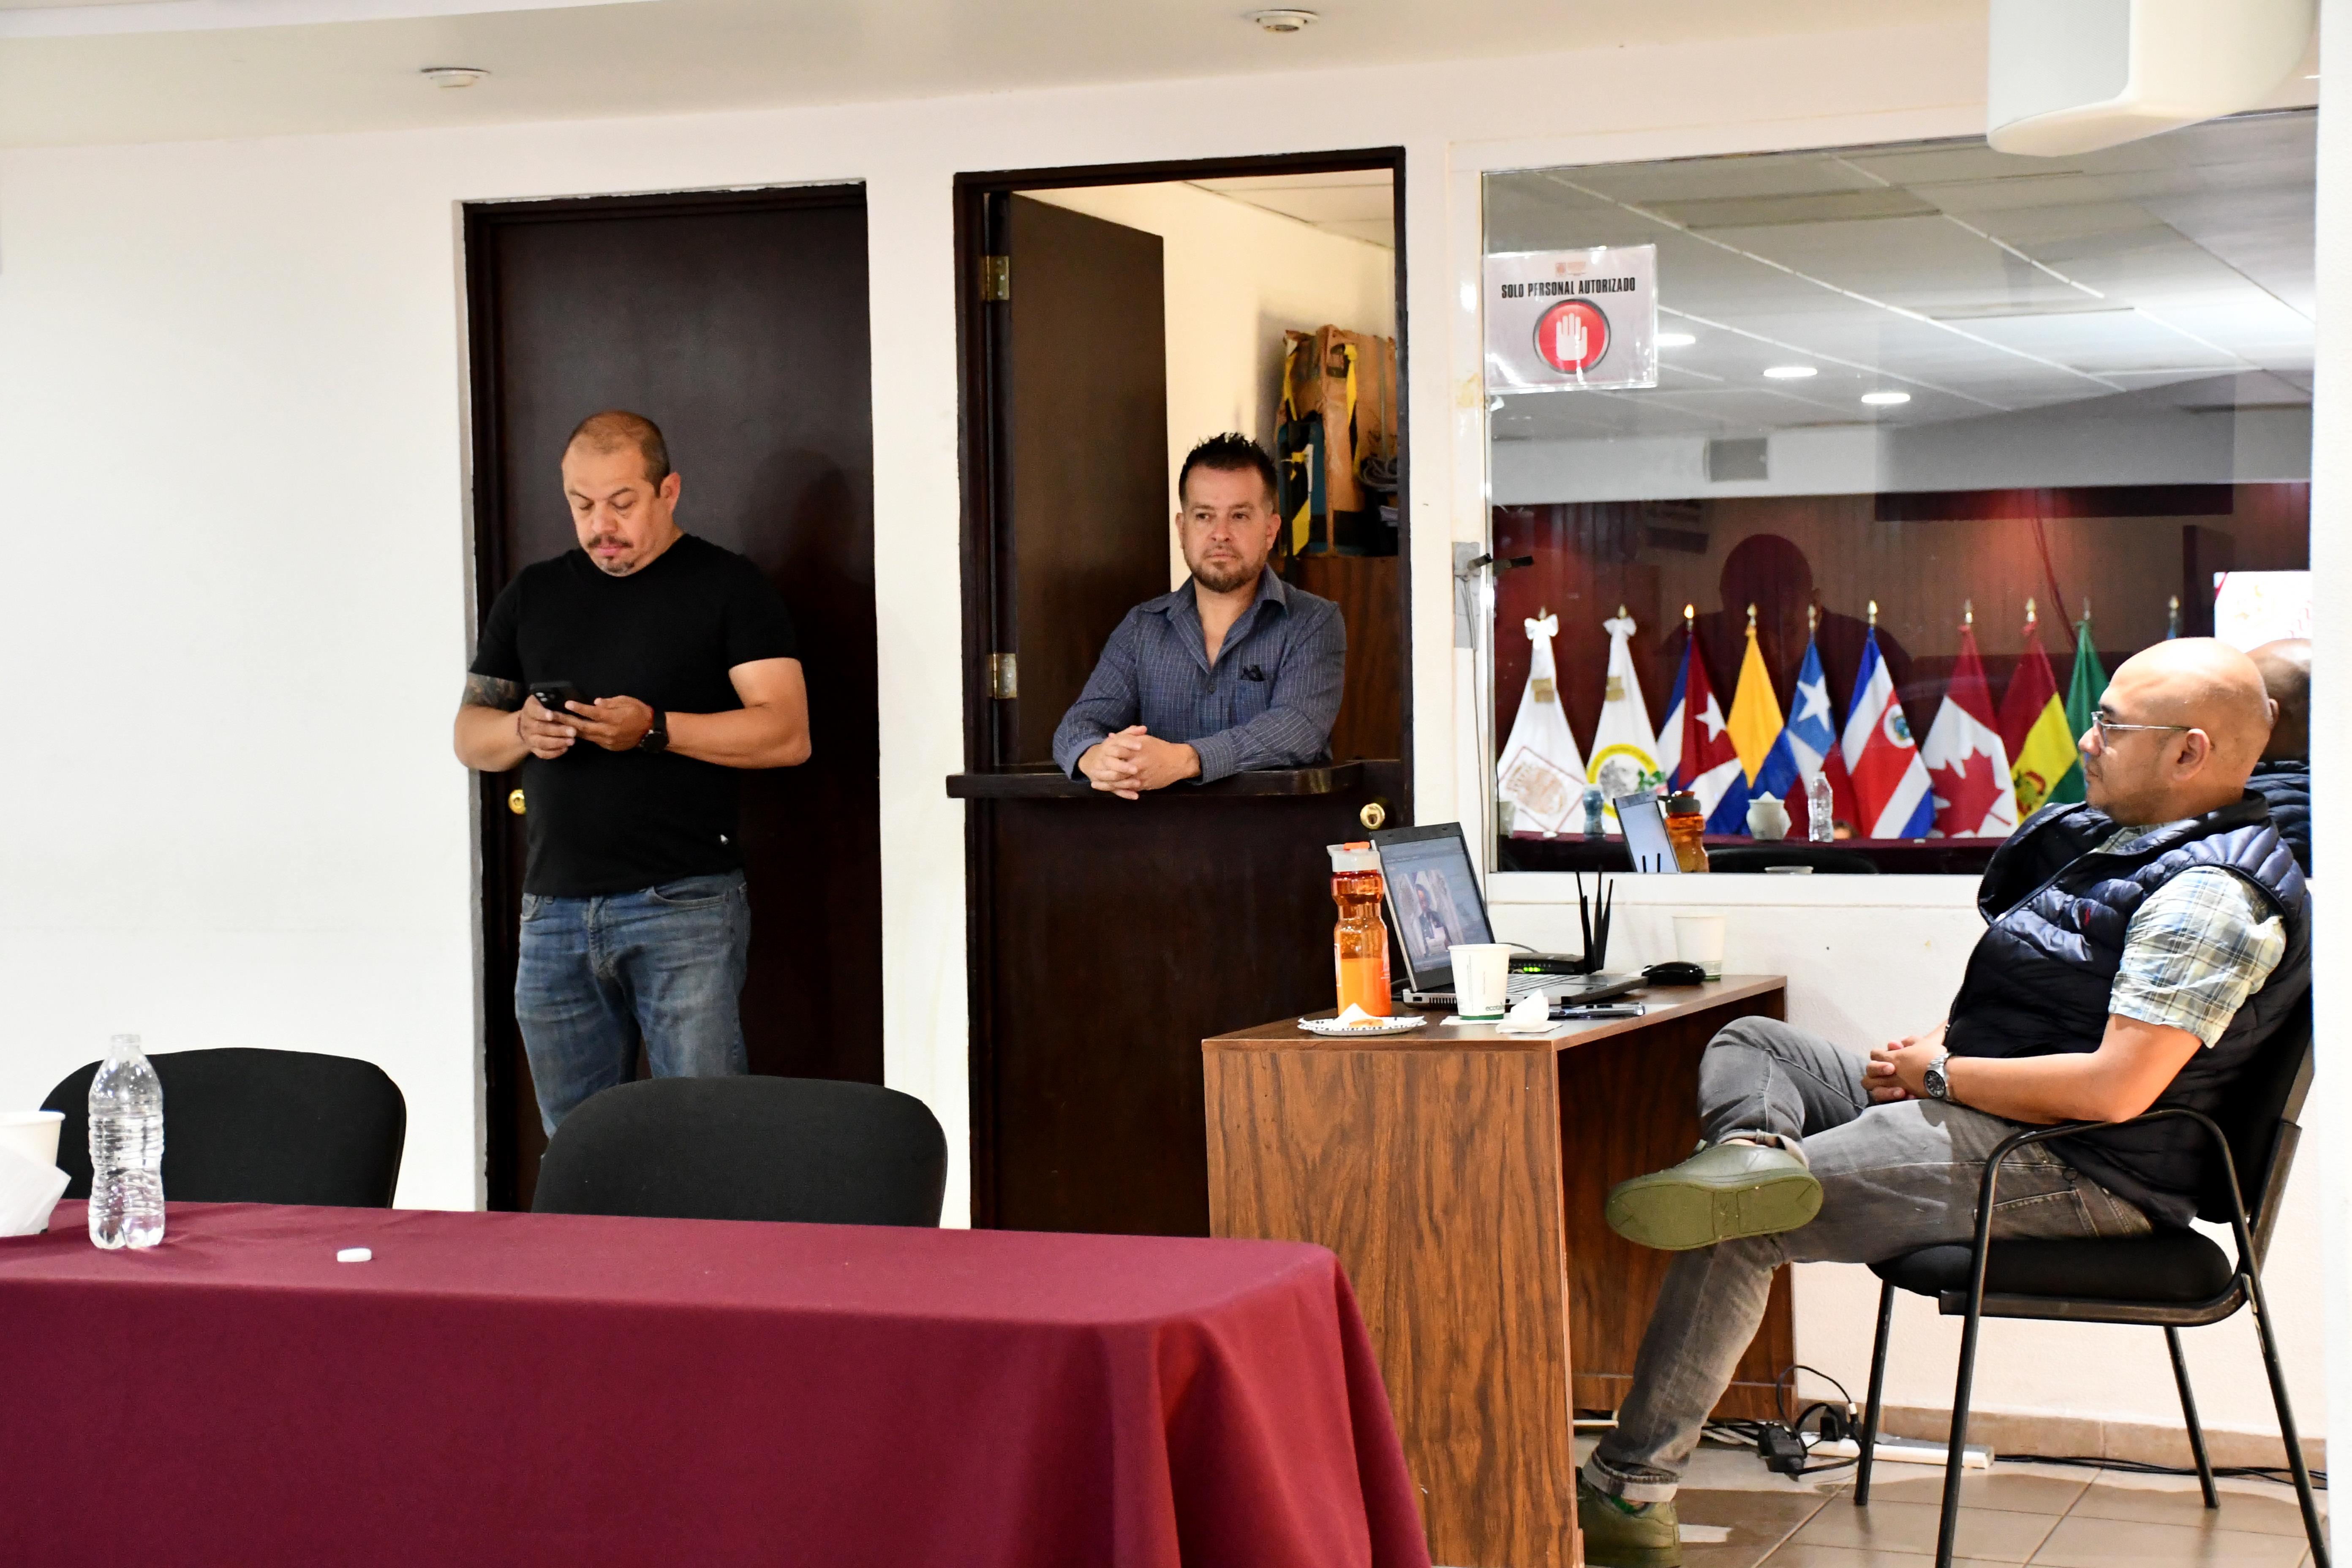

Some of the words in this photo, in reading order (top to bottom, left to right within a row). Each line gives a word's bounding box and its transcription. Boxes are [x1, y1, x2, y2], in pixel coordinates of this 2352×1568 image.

[1502, 284, 1524, 298] SOLO
[1527, 280, 1574, 297] PERSONAL
[1578, 277, 1635, 294] AUTORIZADO
